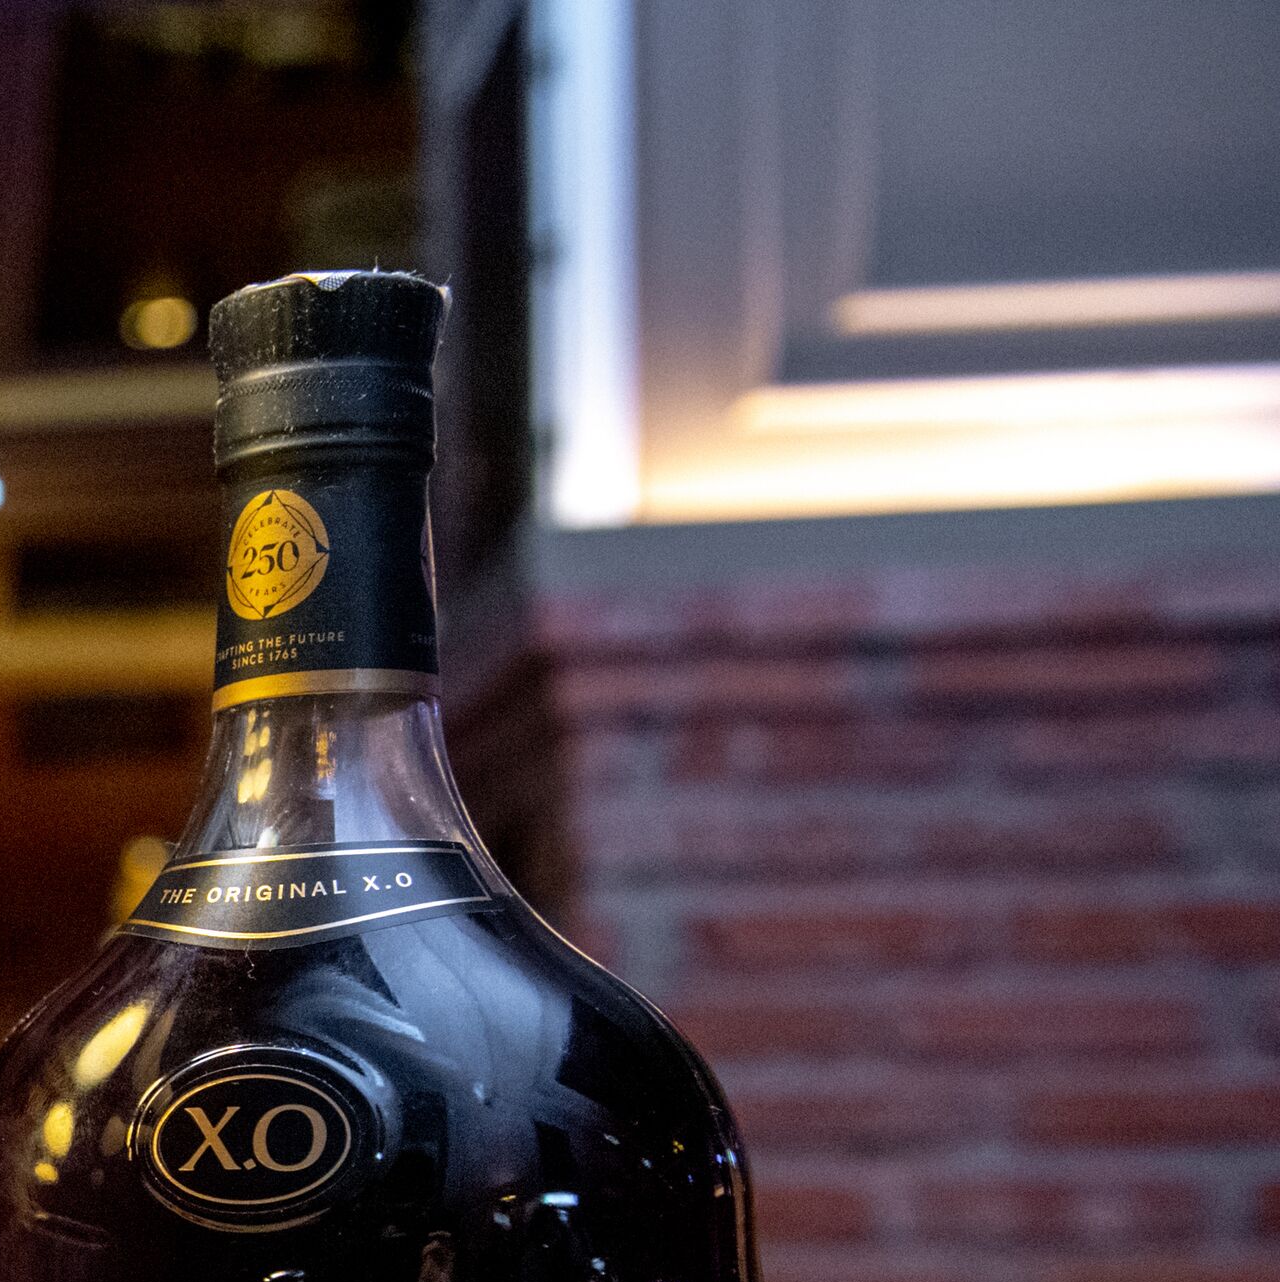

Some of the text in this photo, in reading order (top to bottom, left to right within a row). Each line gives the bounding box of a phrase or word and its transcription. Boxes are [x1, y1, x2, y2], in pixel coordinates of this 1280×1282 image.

[243, 517, 301, 546] CELEBRATE
[241, 540, 300, 580] 250
[249, 582, 287, 597] YEARS
[258, 636, 282, 650] THE
[288, 631, 346, 645] FUTURE
[231, 647, 298, 670] SINCE 1765
[159, 872, 414, 905] THE ORIGINAL X.O
[177, 1103, 328, 1173] X.O
